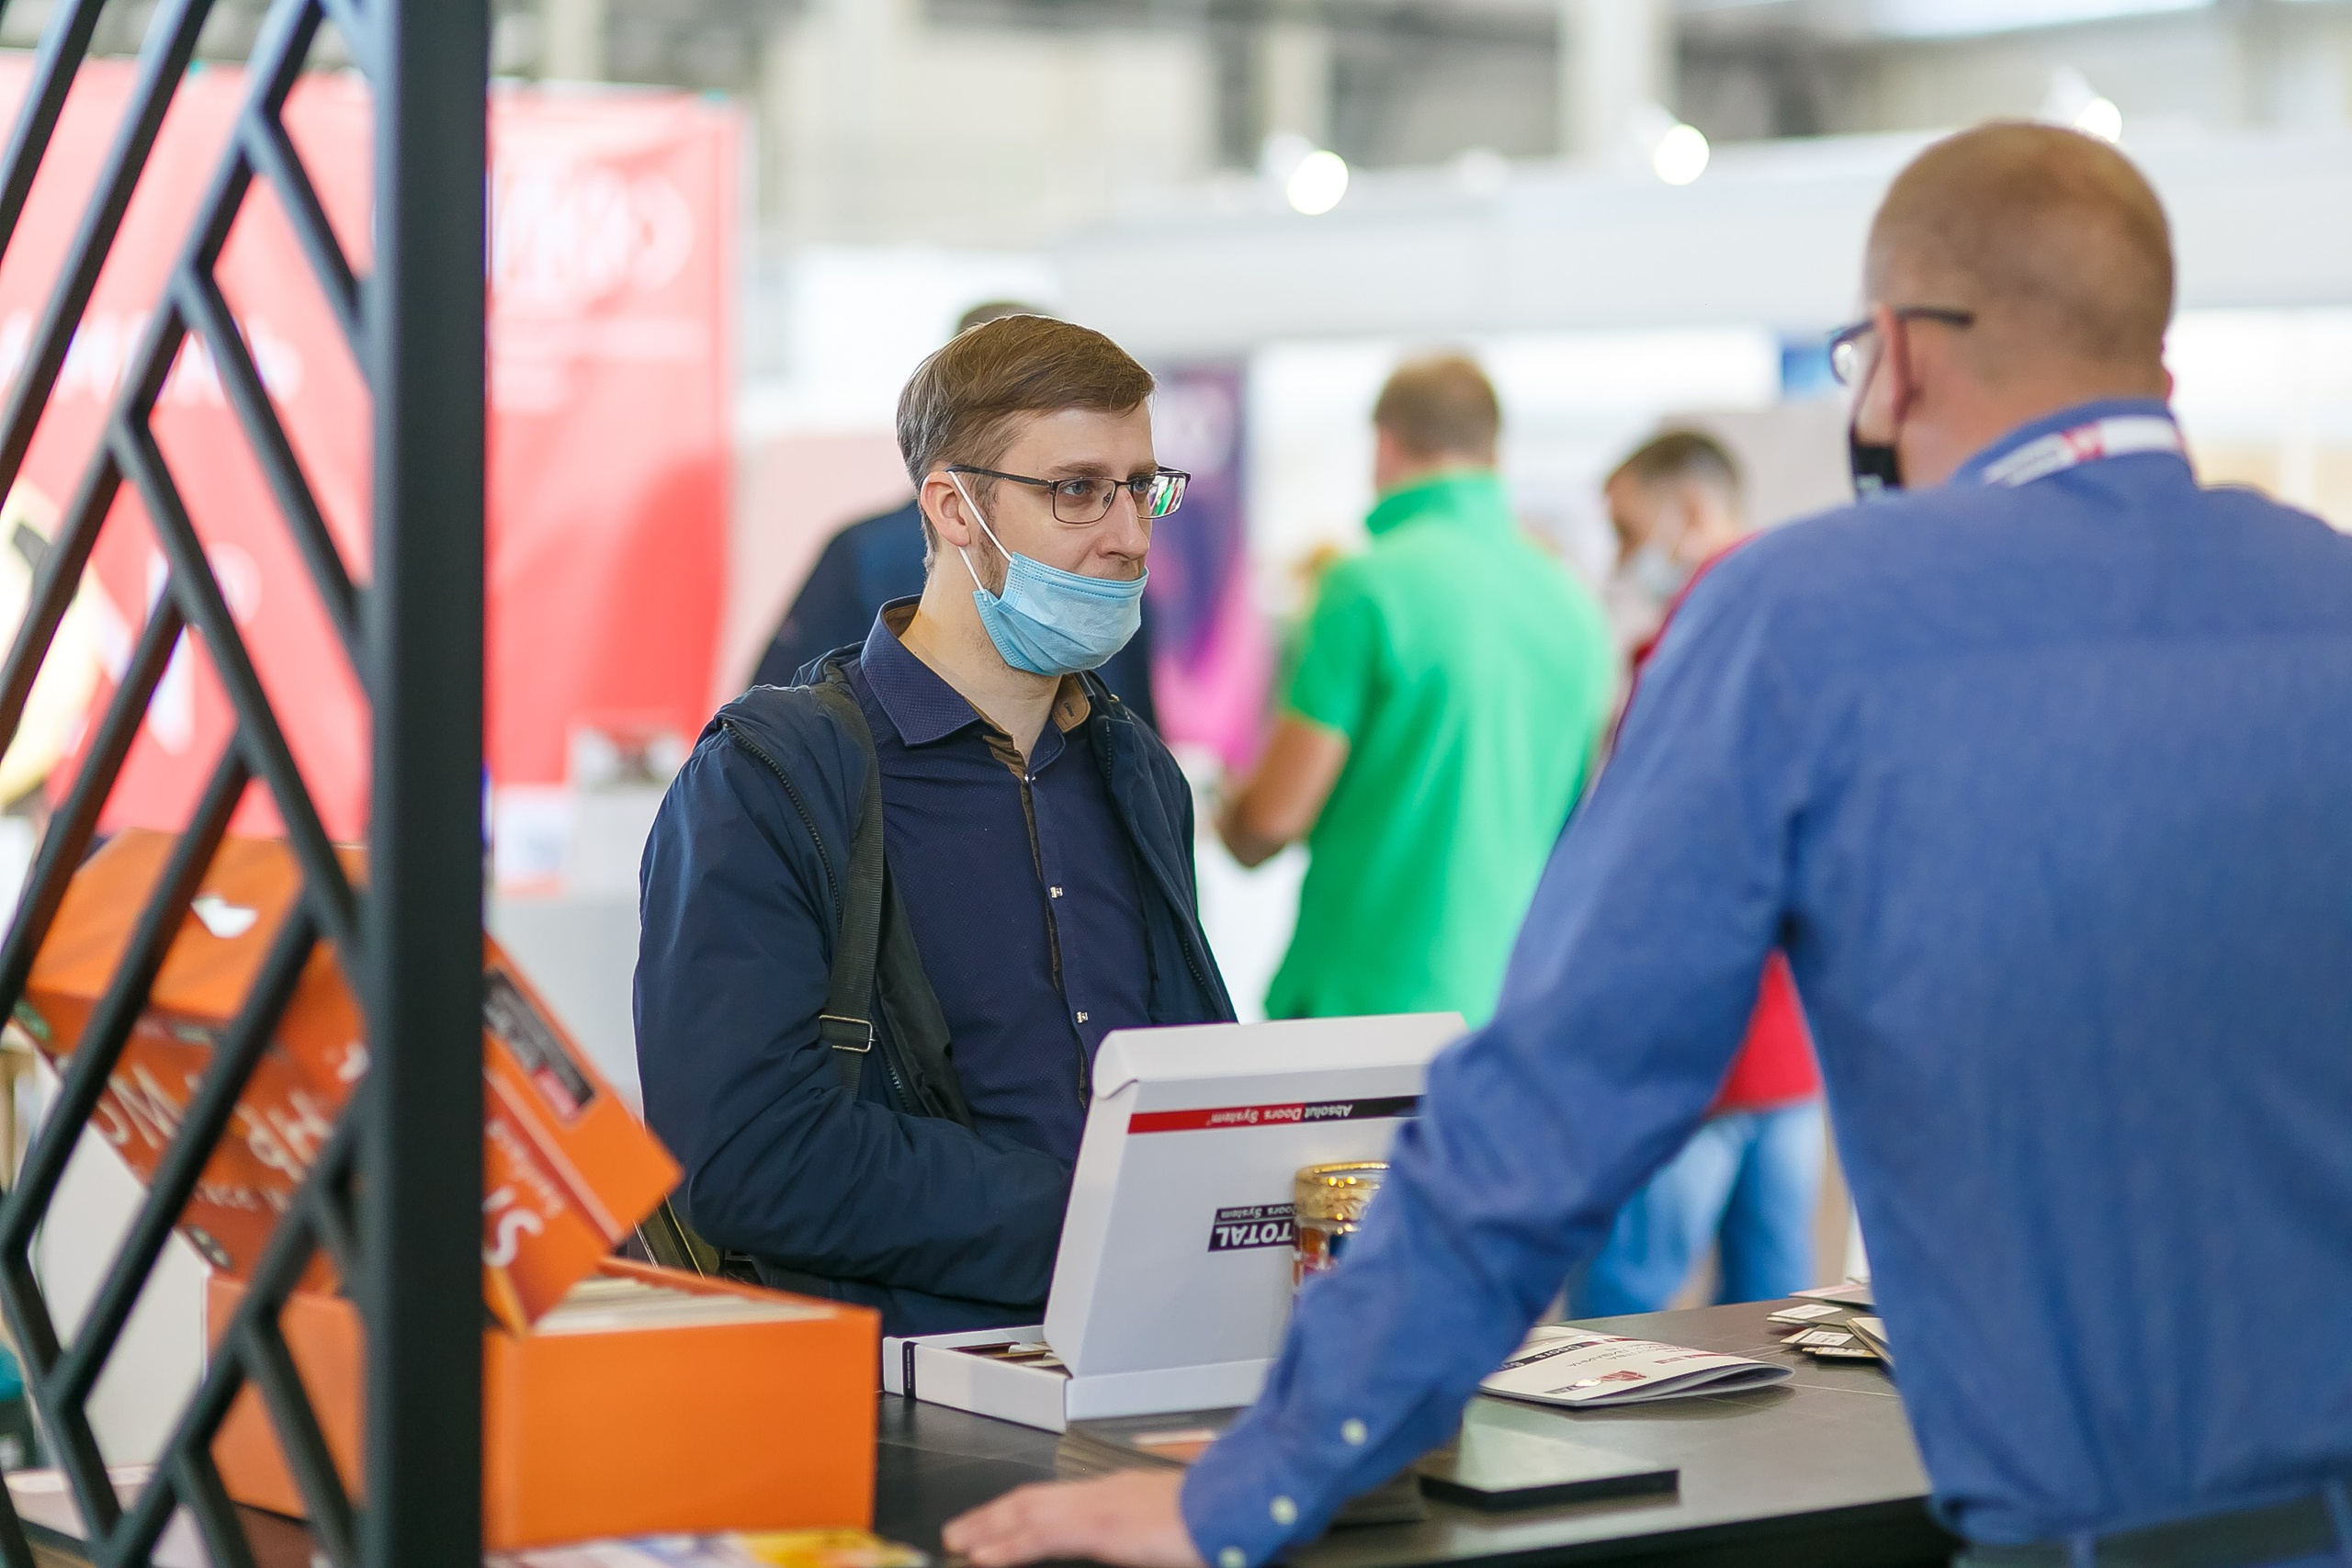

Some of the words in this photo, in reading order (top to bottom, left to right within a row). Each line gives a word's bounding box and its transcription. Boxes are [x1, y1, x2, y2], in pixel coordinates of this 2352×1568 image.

[1211, 1107, 1259, 1123] System
[1263, 1107, 1302, 1121] Doors
[1305, 1104, 1352, 1119] Absolut
[1220, 1206, 1262, 1219] System
[1216, 1223, 1293, 1247] TOTAL
[1534, 1345, 1582, 1359] Doors
